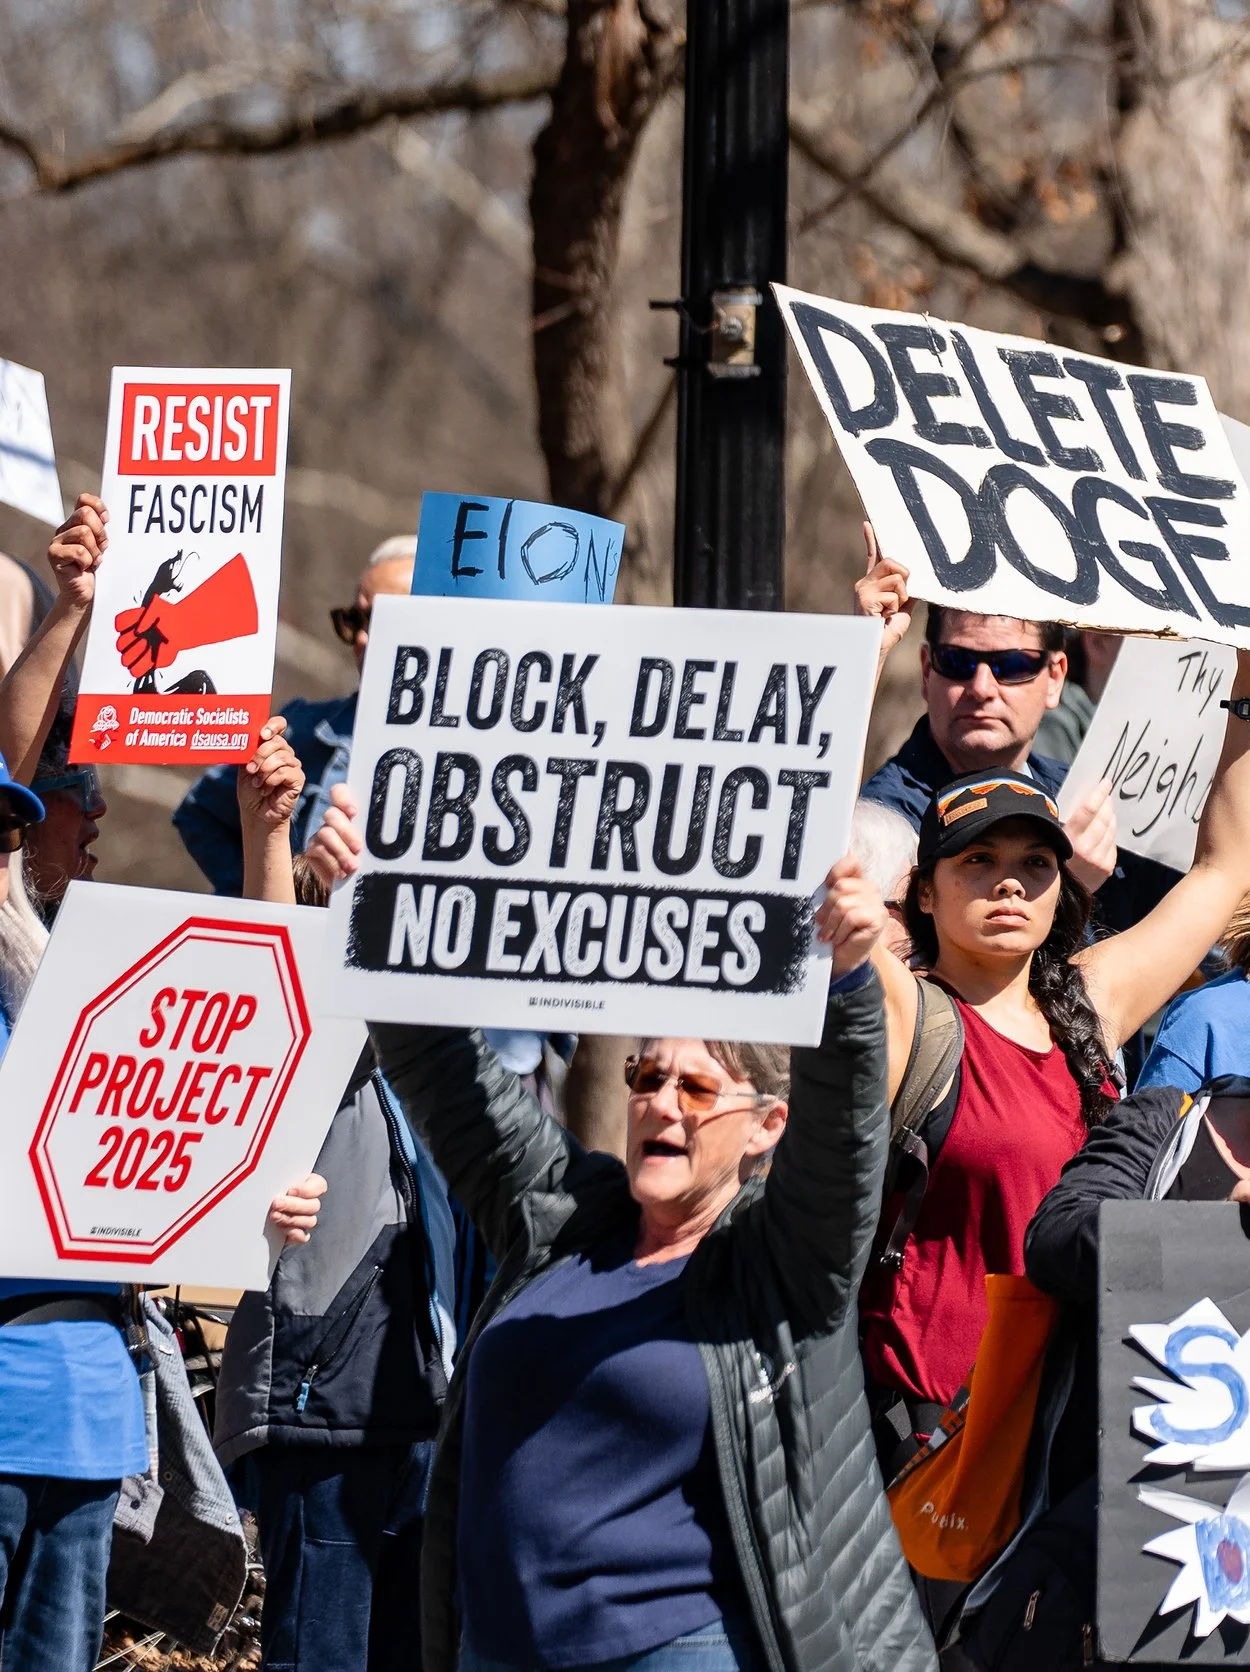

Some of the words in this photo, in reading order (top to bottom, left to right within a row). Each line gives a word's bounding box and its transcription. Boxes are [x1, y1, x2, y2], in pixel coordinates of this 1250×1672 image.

[131, 395, 271, 462] RESIST
[789, 301, 1236, 499] DELETE
[127, 484, 264, 534] FASCISM
[129, 706, 194, 725] Democratic
[195, 707, 250, 725] Socialists
[386, 645, 607, 747] BLOCK,
[629, 657, 836, 760] DELAY,
[1178, 651, 1224, 718] Thy
[125, 728, 139, 746] of
[139, 730, 187, 747] America
[190, 731, 249, 750] dsausa.org
[364, 747, 831, 880] OBSTRUCT
[386, 883, 478, 970] NO
[485, 886, 767, 986] EXCUSES
[139, 986, 258, 1055] STOP
[68, 1052, 273, 1127] PROJECT
[84, 1126, 204, 1193] 2025
